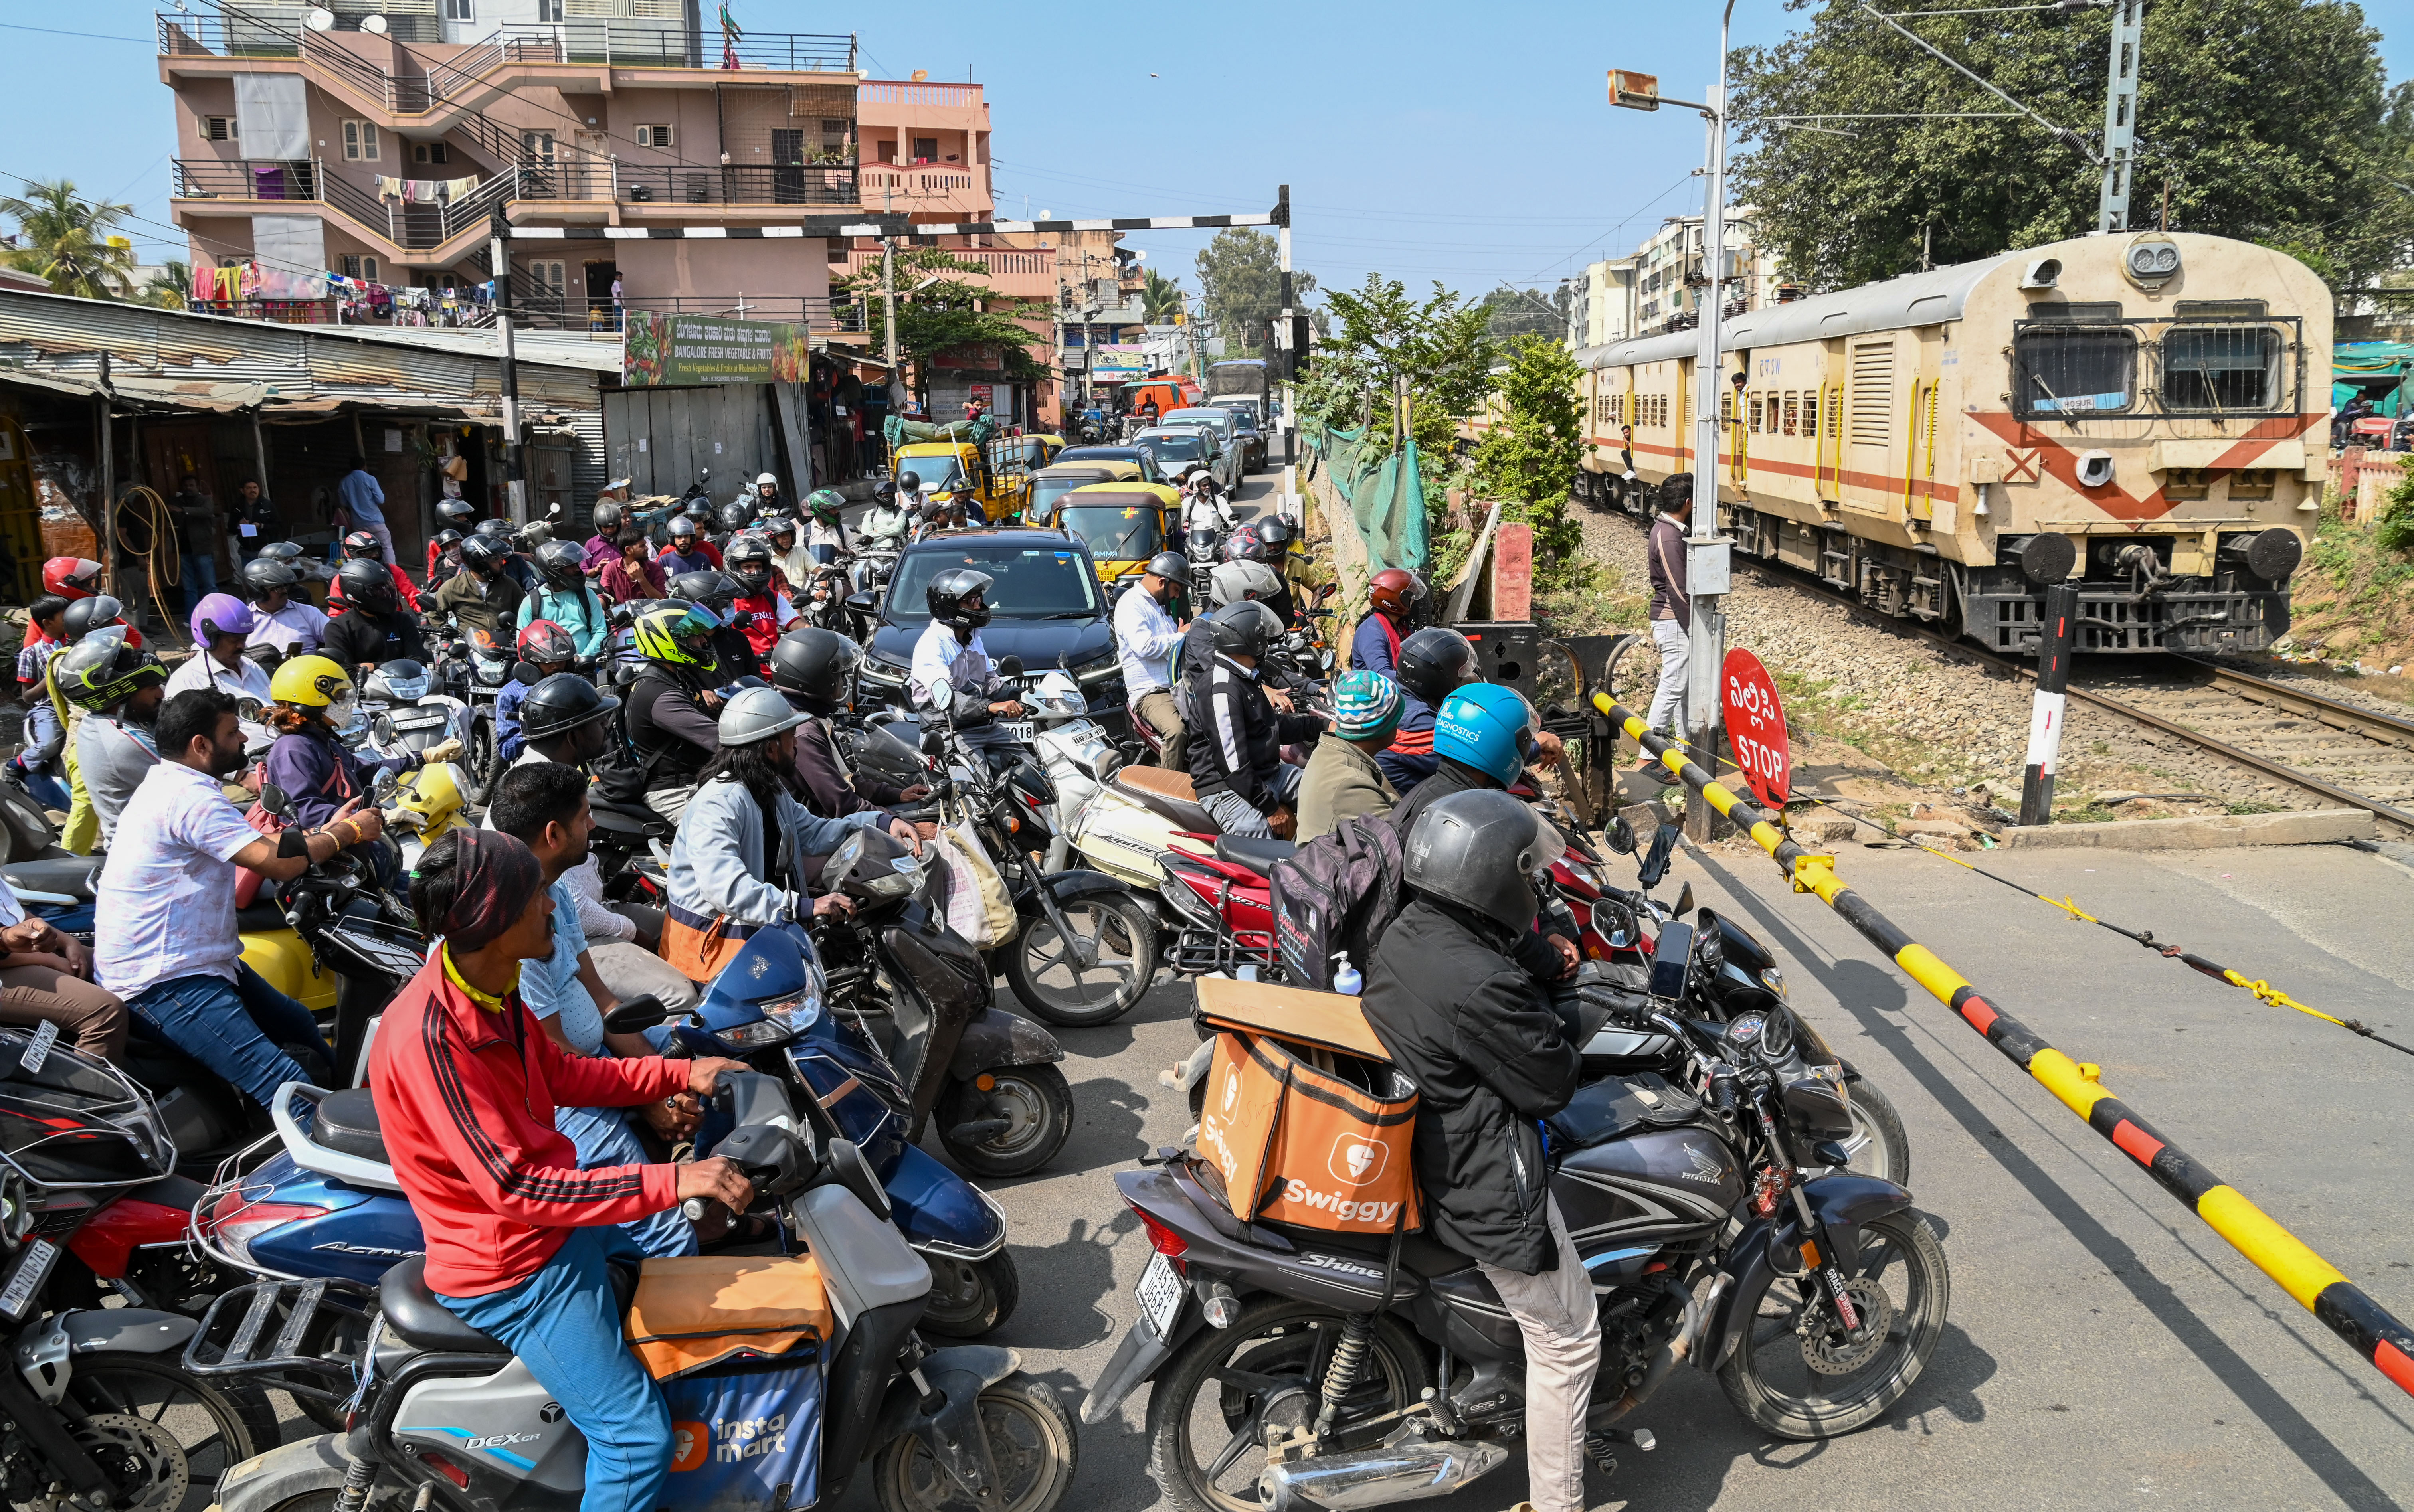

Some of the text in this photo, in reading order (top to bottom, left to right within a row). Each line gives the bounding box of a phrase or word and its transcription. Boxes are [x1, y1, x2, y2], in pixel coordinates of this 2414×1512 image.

[675, 346, 772, 360] BANGALORE FRESH VEGETABLE & FRUITS
[679, 363, 691, 372] Fresh
[693, 363, 715, 374] Vegetables
[716, 364, 720, 372] &
[720, 363, 733, 372] Fruits
[738, 364, 757, 372] Wholesale
[758, 364, 768, 372] Price
[665, 648, 697, 664] AXOR
[1439, 708, 1454, 721] Apollo
[1005, 727, 1033, 739] 018
[1437, 718, 1480, 742] DIAGNOSTICS
[1738, 735, 1783, 783] STOP
[1682, 1172, 1721, 1186] HONDA
[1284, 1178, 1399, 1223] Swiggy
[1296, 1253, 1383, 1279] Shine
[1155, 1257, 1177, 1303] KA53H
[1145, 1272, 1168, 1323] U6681
[1826, 1268, 1843, 1295] GRACE
[1840, 1291, 1857, 1326] MOTORS
[717, 1413, 786, 1441] insta
[464, 1431, 542, 1450] DEX GR
[716, 1434, 786, 1463] mart
